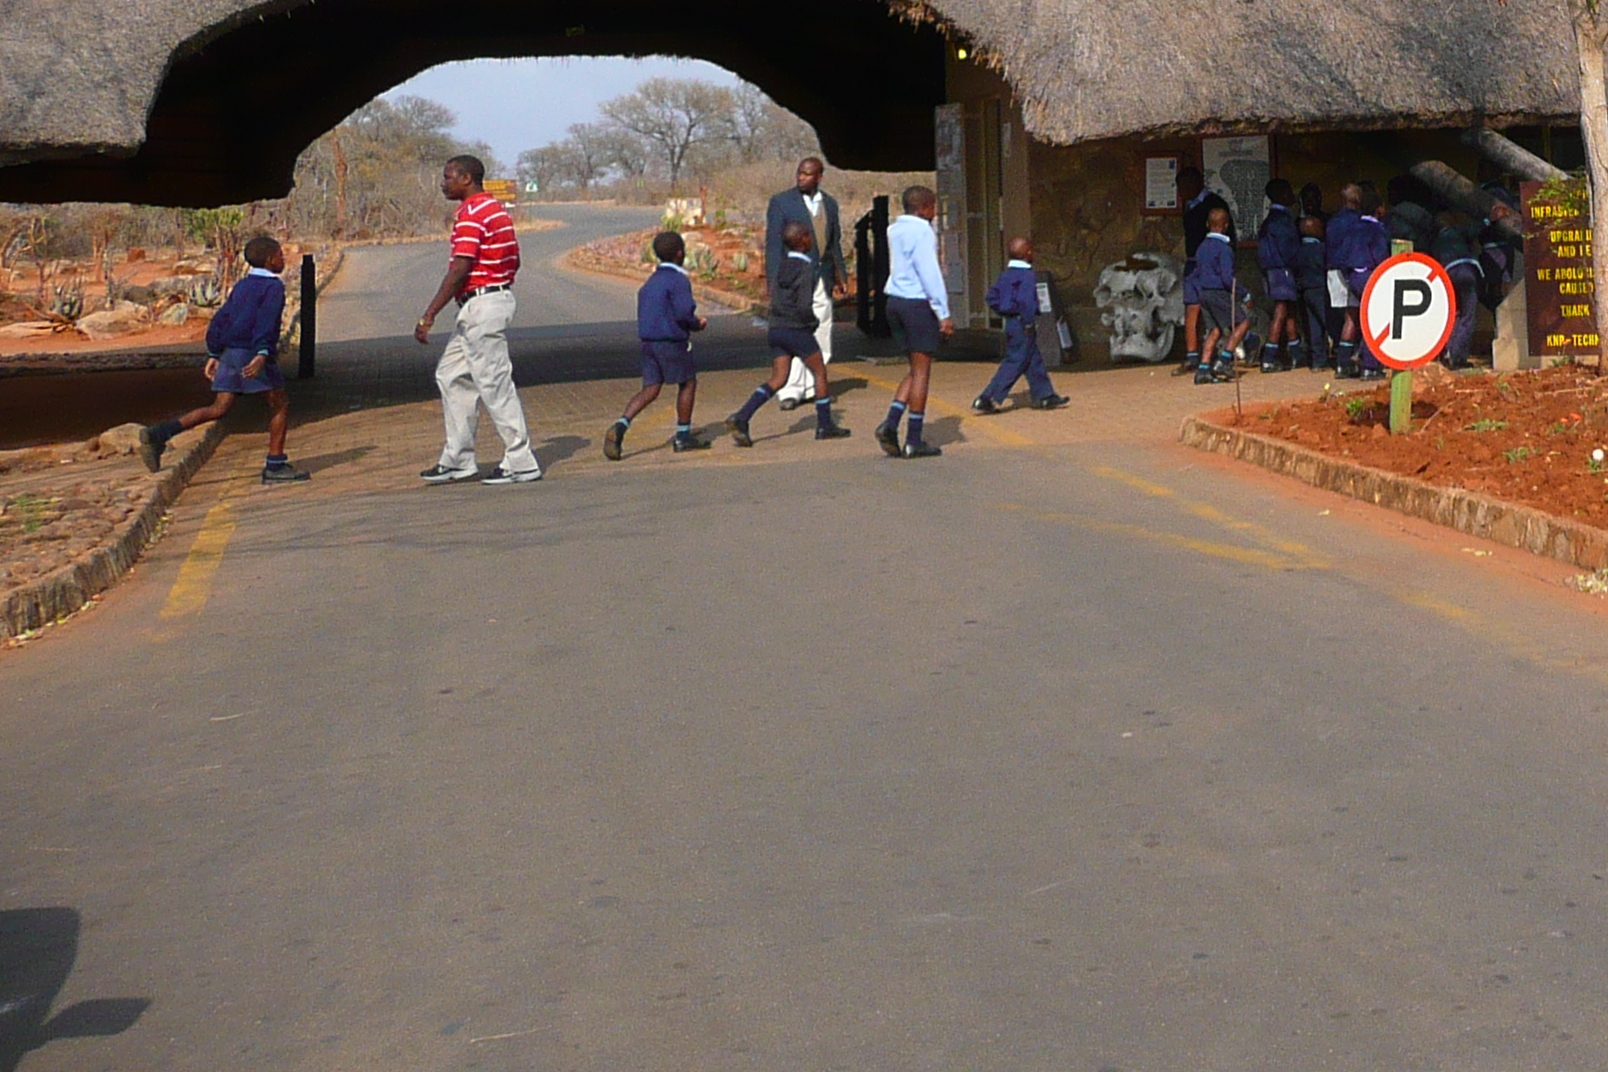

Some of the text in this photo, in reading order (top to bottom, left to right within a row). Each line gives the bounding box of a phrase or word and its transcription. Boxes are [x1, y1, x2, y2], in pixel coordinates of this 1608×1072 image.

[1557, 245, 1576, 258] AND
[1537, 268, 1551, 281] WE
[1392, 278, 1432, 340] P
[1560, 304, 1590, 318] THANK
